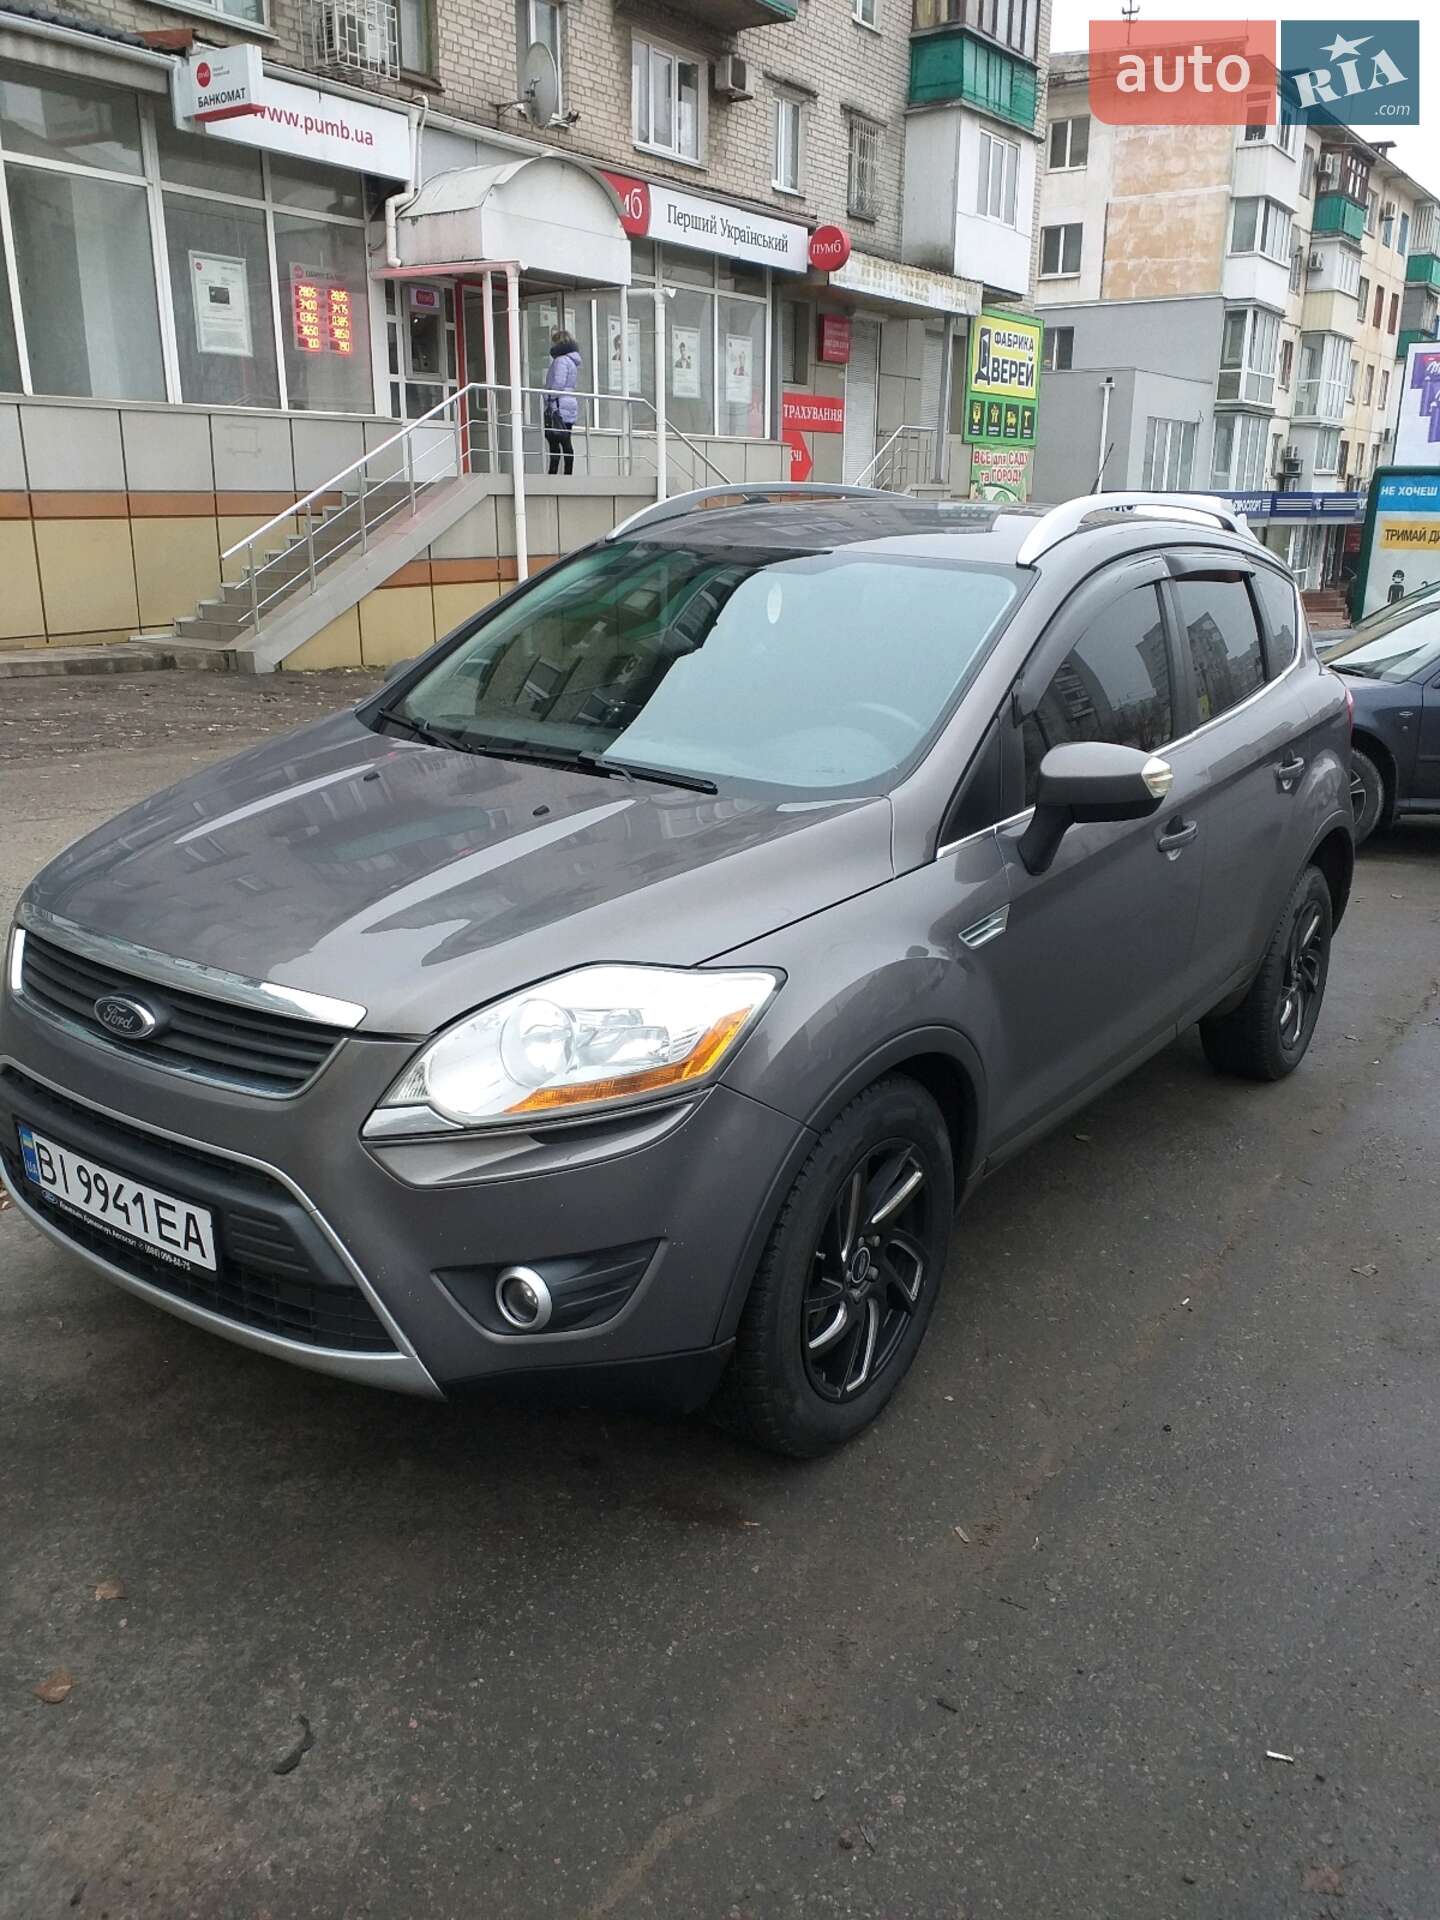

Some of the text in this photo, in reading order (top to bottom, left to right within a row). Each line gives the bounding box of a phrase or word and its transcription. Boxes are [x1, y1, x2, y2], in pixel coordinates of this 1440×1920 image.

[198, 87, 246, 109] БАНКОМАТ
[667, 203, 788, 253] Перший Український
[994, 331, 1034, 352] ФАБРИКА
[975, 327, 1035, 388] ДВЕРЕЙ
[974, 450, 991, 465] ВСЕ
[980, 472, 990, 482] та
[1381, 486, 1438, 497] НЕ ХОЧЕШ
[1385, 527, 1427, 542] ТРИМАЙ
[103, 1003, 135, 1029] Ford
